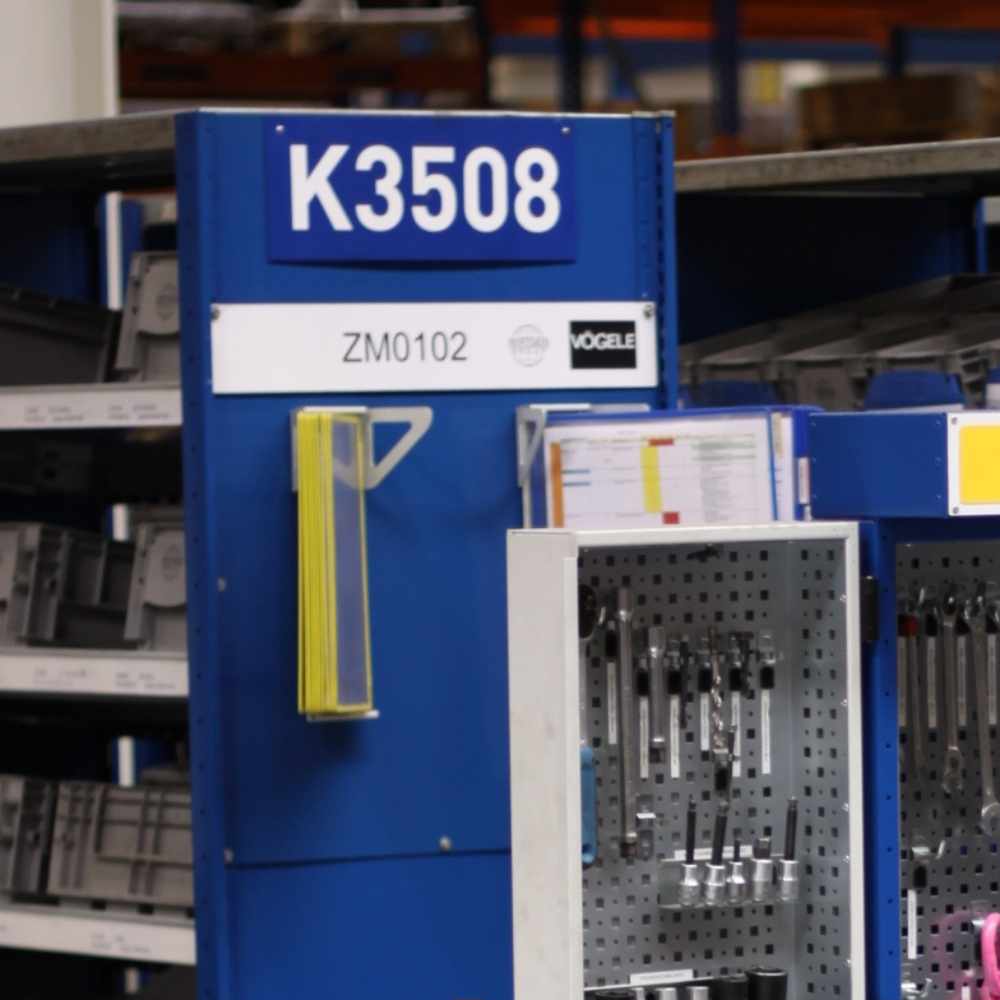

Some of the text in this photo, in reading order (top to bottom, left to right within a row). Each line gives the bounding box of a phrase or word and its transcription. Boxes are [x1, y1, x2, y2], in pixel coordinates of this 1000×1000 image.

[289, 144, 561, 233] K3508
[342, 331, 469, 363] ZM0102
[571, 329, 635, 350] VÖGELE
